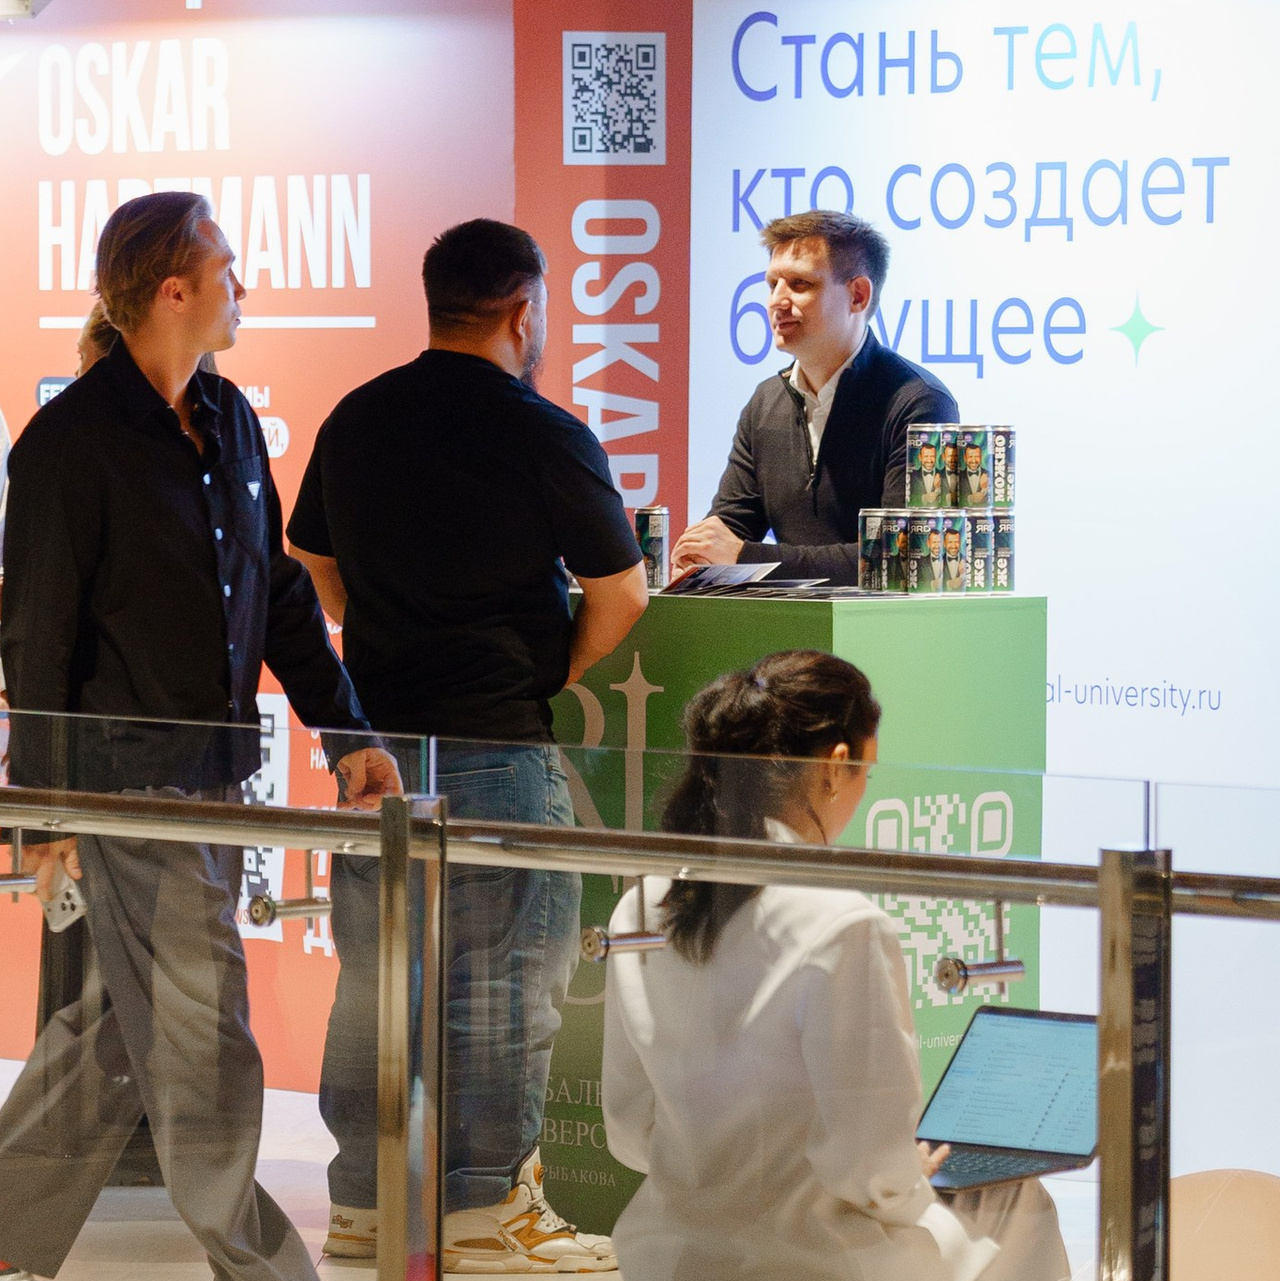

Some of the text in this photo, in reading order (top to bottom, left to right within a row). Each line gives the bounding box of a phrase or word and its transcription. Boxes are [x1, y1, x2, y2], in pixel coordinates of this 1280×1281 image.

[38, 38, 230, 156] OSKAR
[731, 10, 1163, 103] Стань тем,
[732, 156, 1231, 243] кто создает
[729, 270, 1087, 379] бущее
